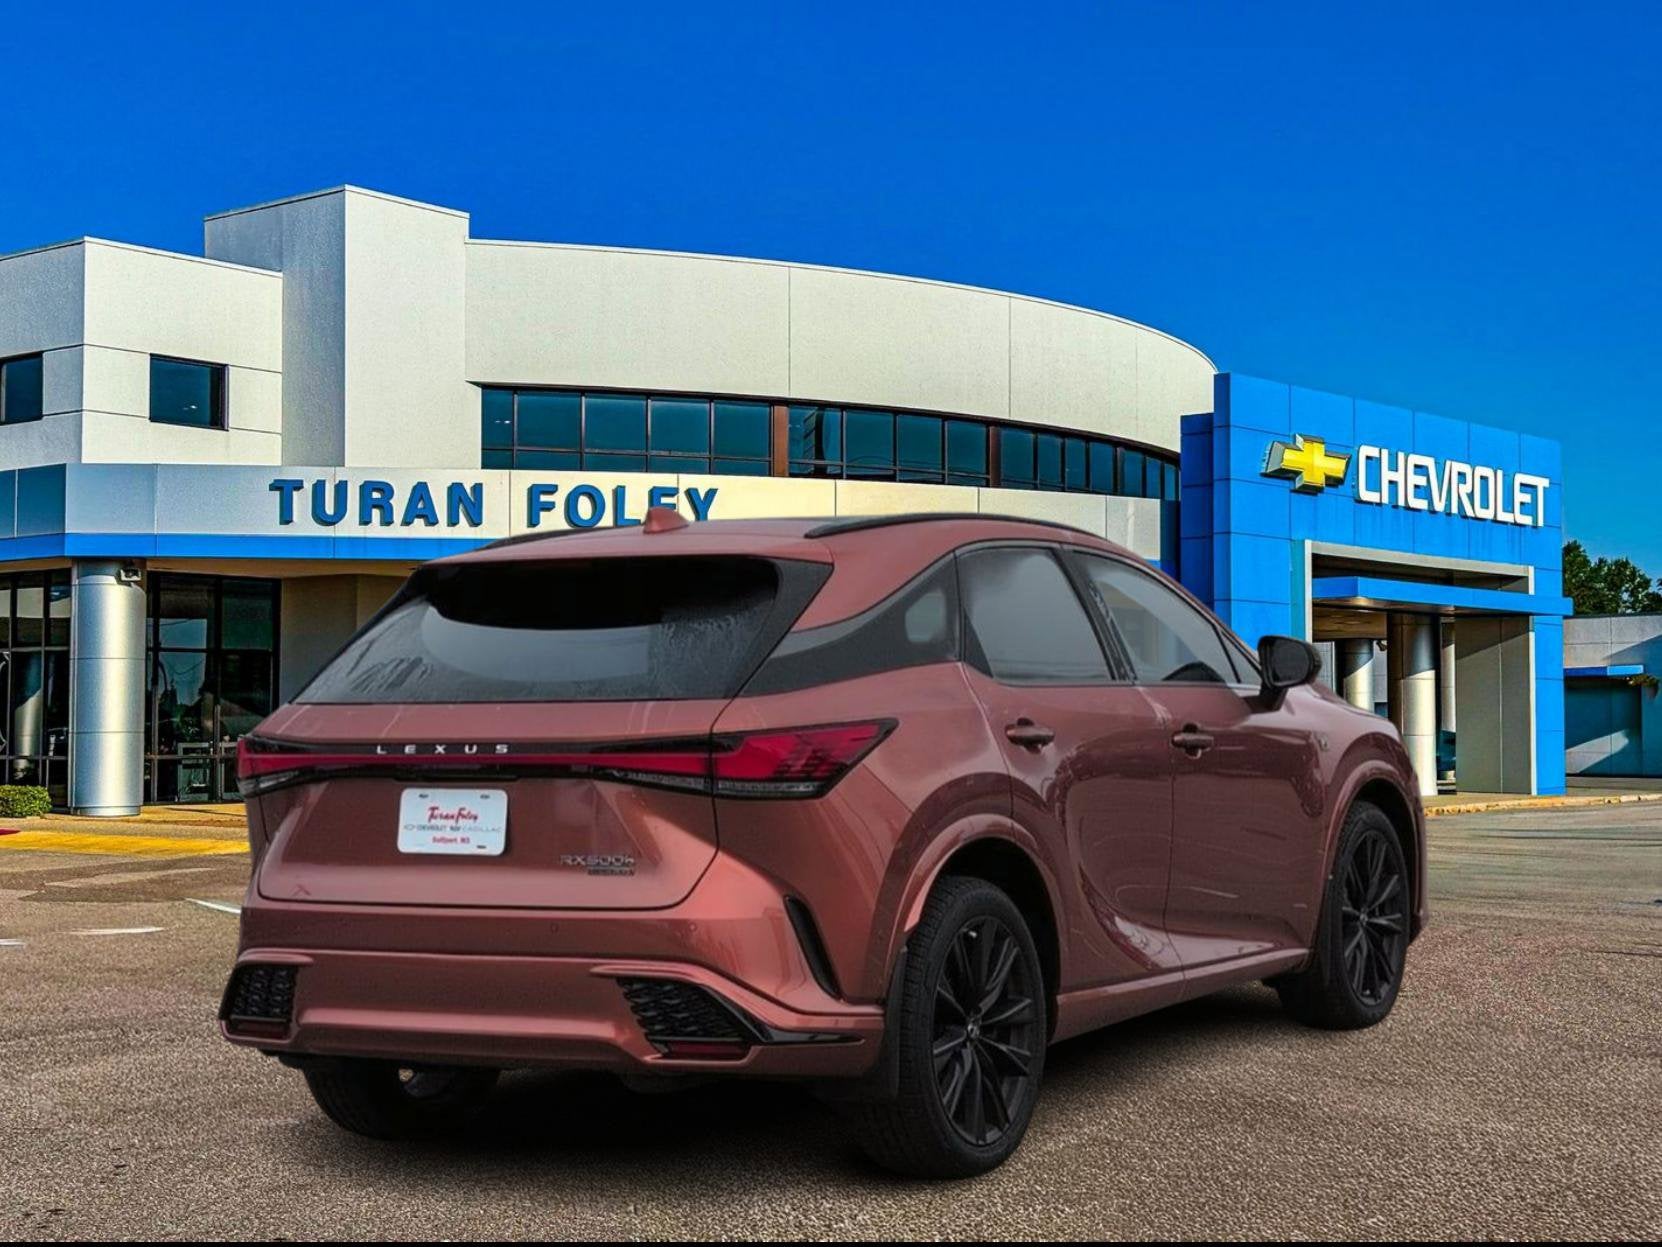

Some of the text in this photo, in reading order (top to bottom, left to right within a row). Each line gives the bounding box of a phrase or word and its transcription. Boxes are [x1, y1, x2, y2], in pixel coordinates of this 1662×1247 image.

[269, 479, 483, 527] TURAN
[1357, 444, 1550, 527] CHEVROLET
[376, 744, 508, 755] LEXUS
